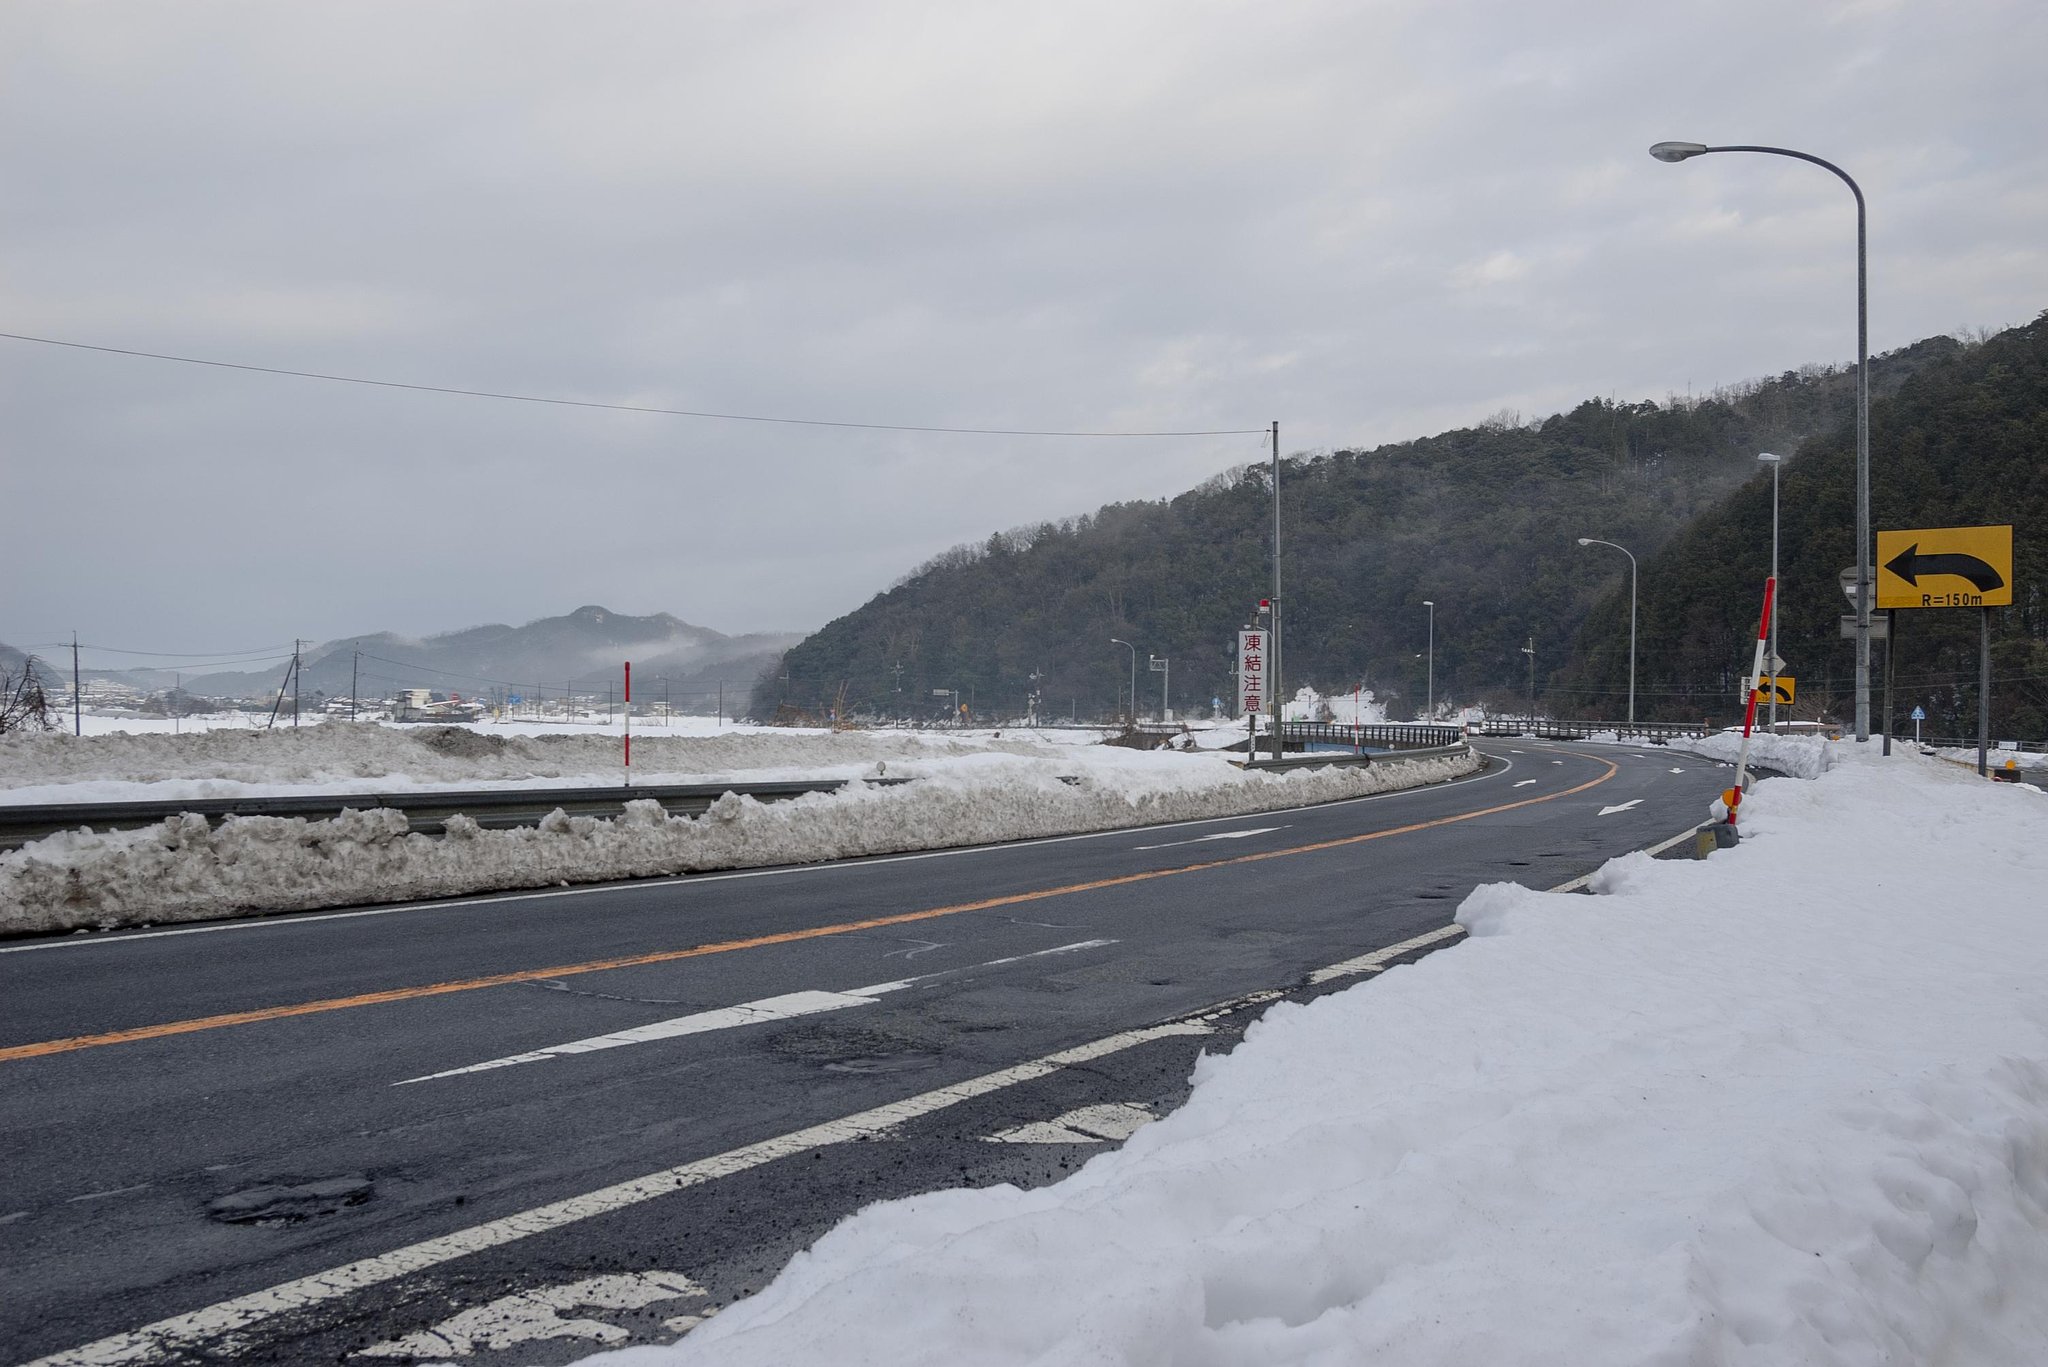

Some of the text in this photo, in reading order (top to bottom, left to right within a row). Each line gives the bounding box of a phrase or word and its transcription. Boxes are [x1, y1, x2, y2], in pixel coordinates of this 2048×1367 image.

[1922, 593, 1982, 606] R=150m
[1244, 634, 1261, 712] 凍結注意
